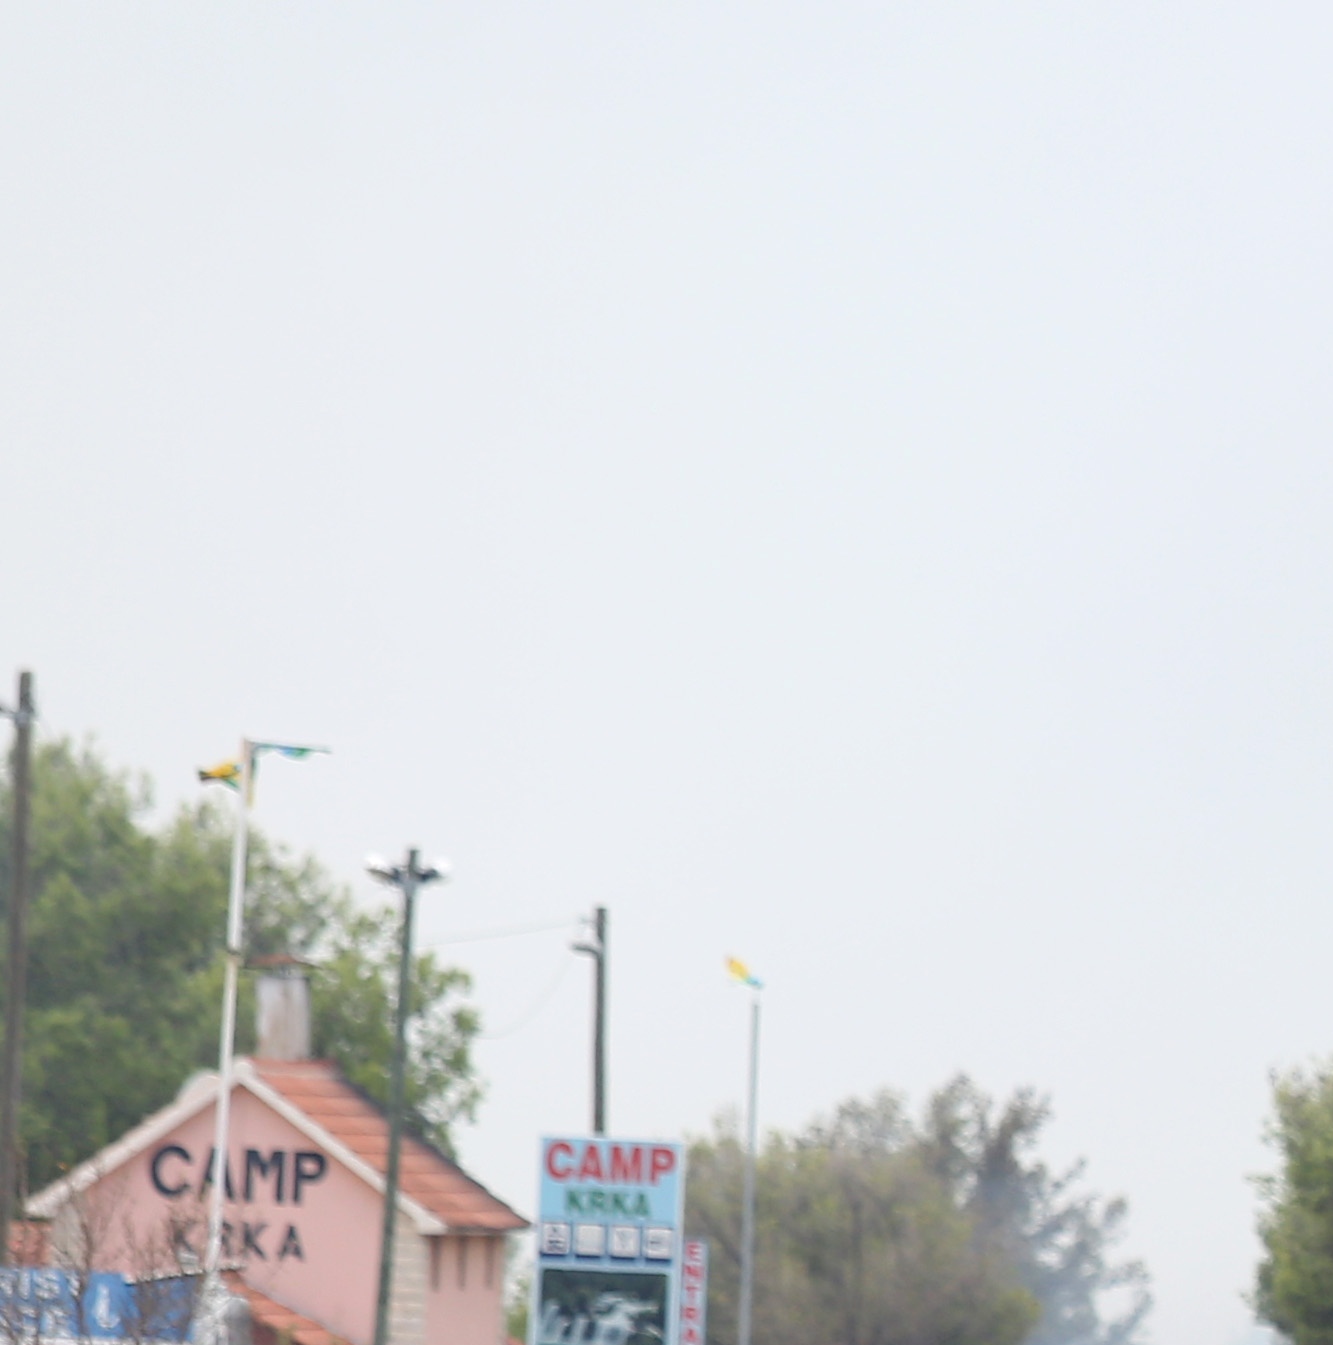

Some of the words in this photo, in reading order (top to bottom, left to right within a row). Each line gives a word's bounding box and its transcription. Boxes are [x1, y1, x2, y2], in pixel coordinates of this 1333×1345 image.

[149, 1144, 328, 1205] CAMP
[545, 1141, 676, 1185] CAMP
[565, 1189, 650, 1217] KRKA
